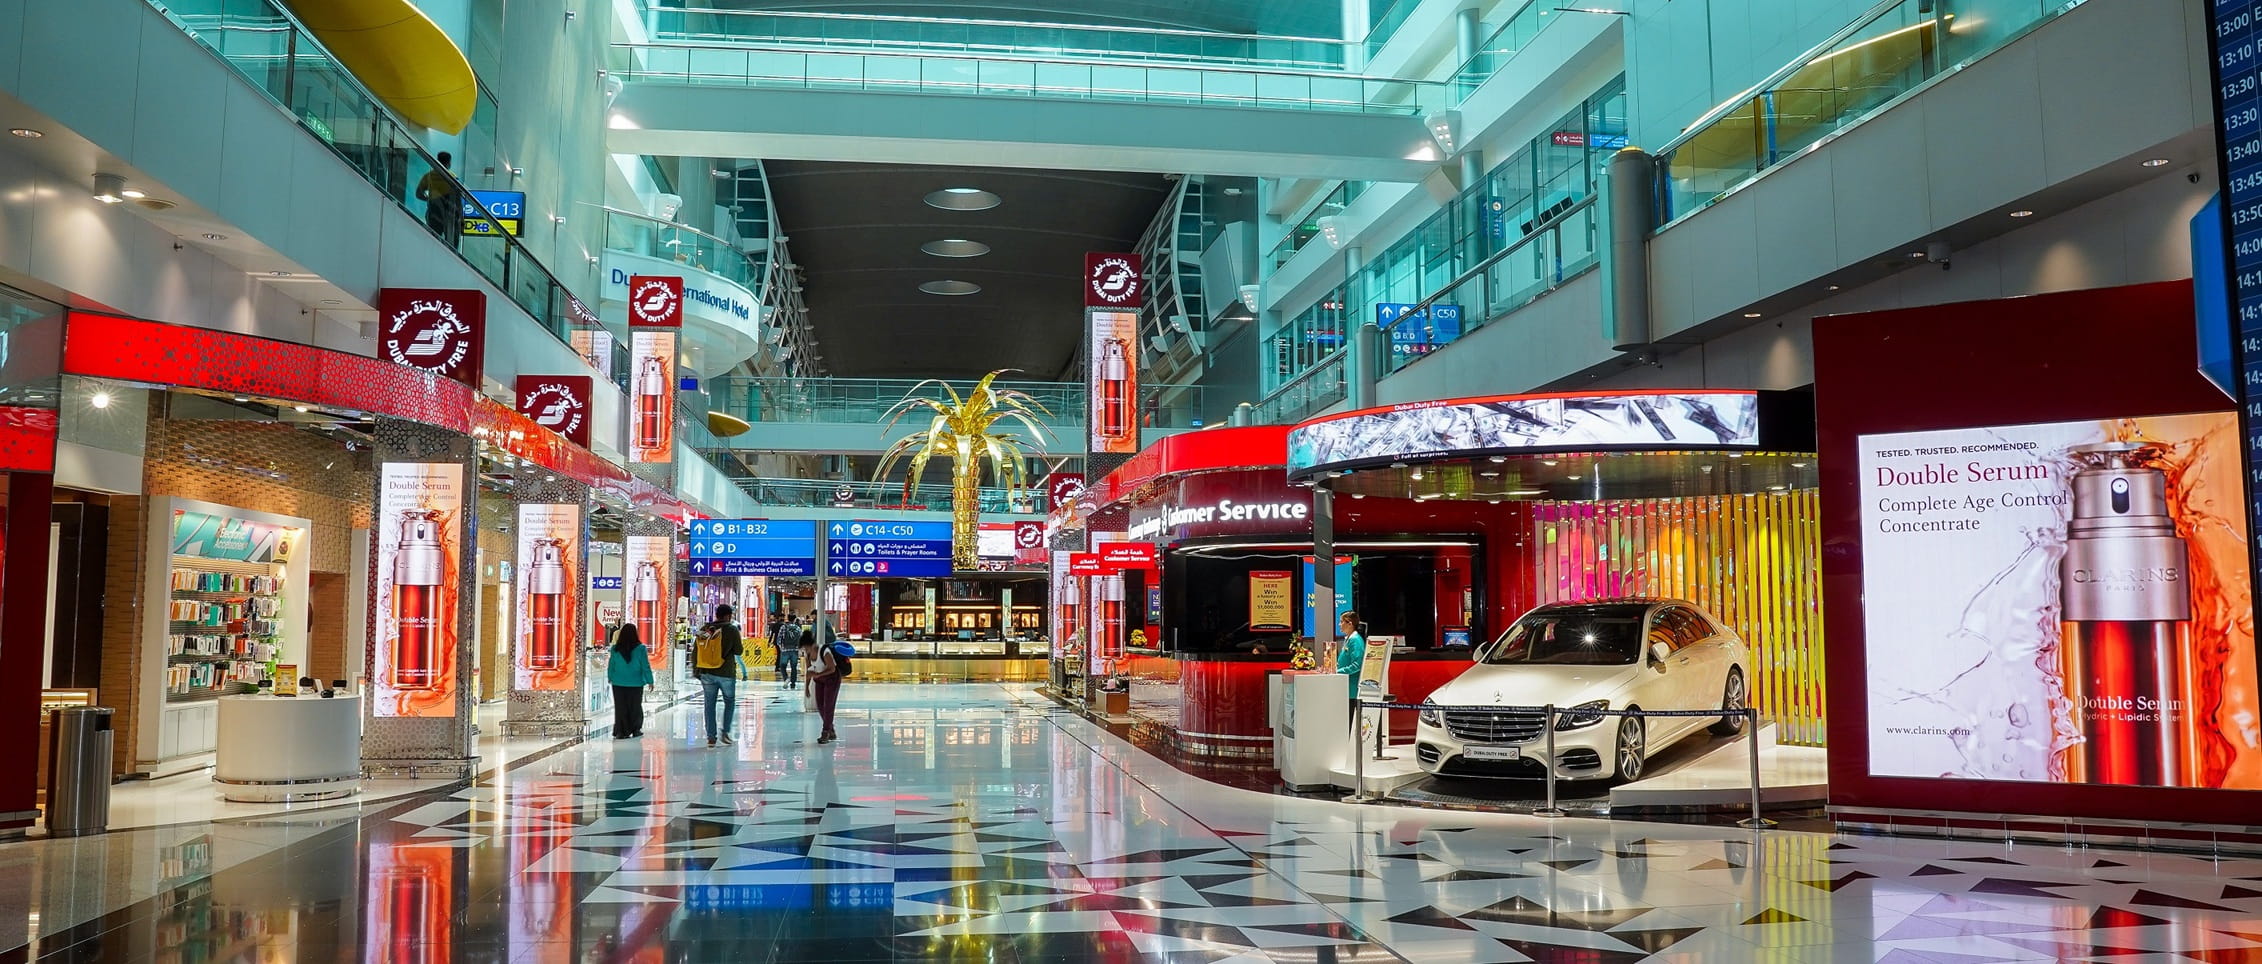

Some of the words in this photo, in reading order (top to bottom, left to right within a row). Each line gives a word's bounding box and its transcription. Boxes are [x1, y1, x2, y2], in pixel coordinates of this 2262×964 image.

[2216, 12, 2249, 38] 13:00
[2219, 44, 2252, 68] 13:10
[2222, 76, 2254, 100] 13:30
[2224, 108, 2257, 130] 13:30
[2227, 140, 2260, 162] 13:40
[2230, 171, 2262, 194] 13:45
[2234, 238, 2262, 256] 14:0
[2236, 270, 2262, 288] 14:1
[1092, 280, 1108, 299] DUBAI
[1107, 294, 1126, 302] DUTY
[1125, 281, 1137, 298] FREE
[633, 301, 648, 319] DUBAI
[664, 302, 676, 318] FREE
[683, 287, 730, 312] rnational
[732, 299, 748, 320] Hotel
[440, 303, 471, 335] السوق
[447, 340, 468, 368] FREE
[566, 413, 582, 434] FREE
[1876, 449, 1912, 458] TESTED.
[1915, 446, 1958, 456] TRUSTED.
[1962, 442, 2039, 453] RECOMMENDED.
[1876, 463, 1959, 487] Double
[1967, 462, 2048, 482] Serum
[389, 482, 420, 490] Double
[422, 482, 450, 490] Serum
[1879, 495, 1957, 515] Complete
[1963, 494, 1995, 512] Age
[2001, 490, 2068, 507] Control
[1168, 505, 1216, 528] Customer
[1219, 500, 1308, 520] Service
[1880, 518, 1981, 533] Concentrate
[728, 544, 736, 553] D
[2072, 567, 2178, 583] CLARINS
[604, 609, 621, 617] New
[2078, 696, 2132, 710] Double
[2118, 713, 2150, 721] Lipidic
[1886, 726, 1970, 736] www.clarins.com
